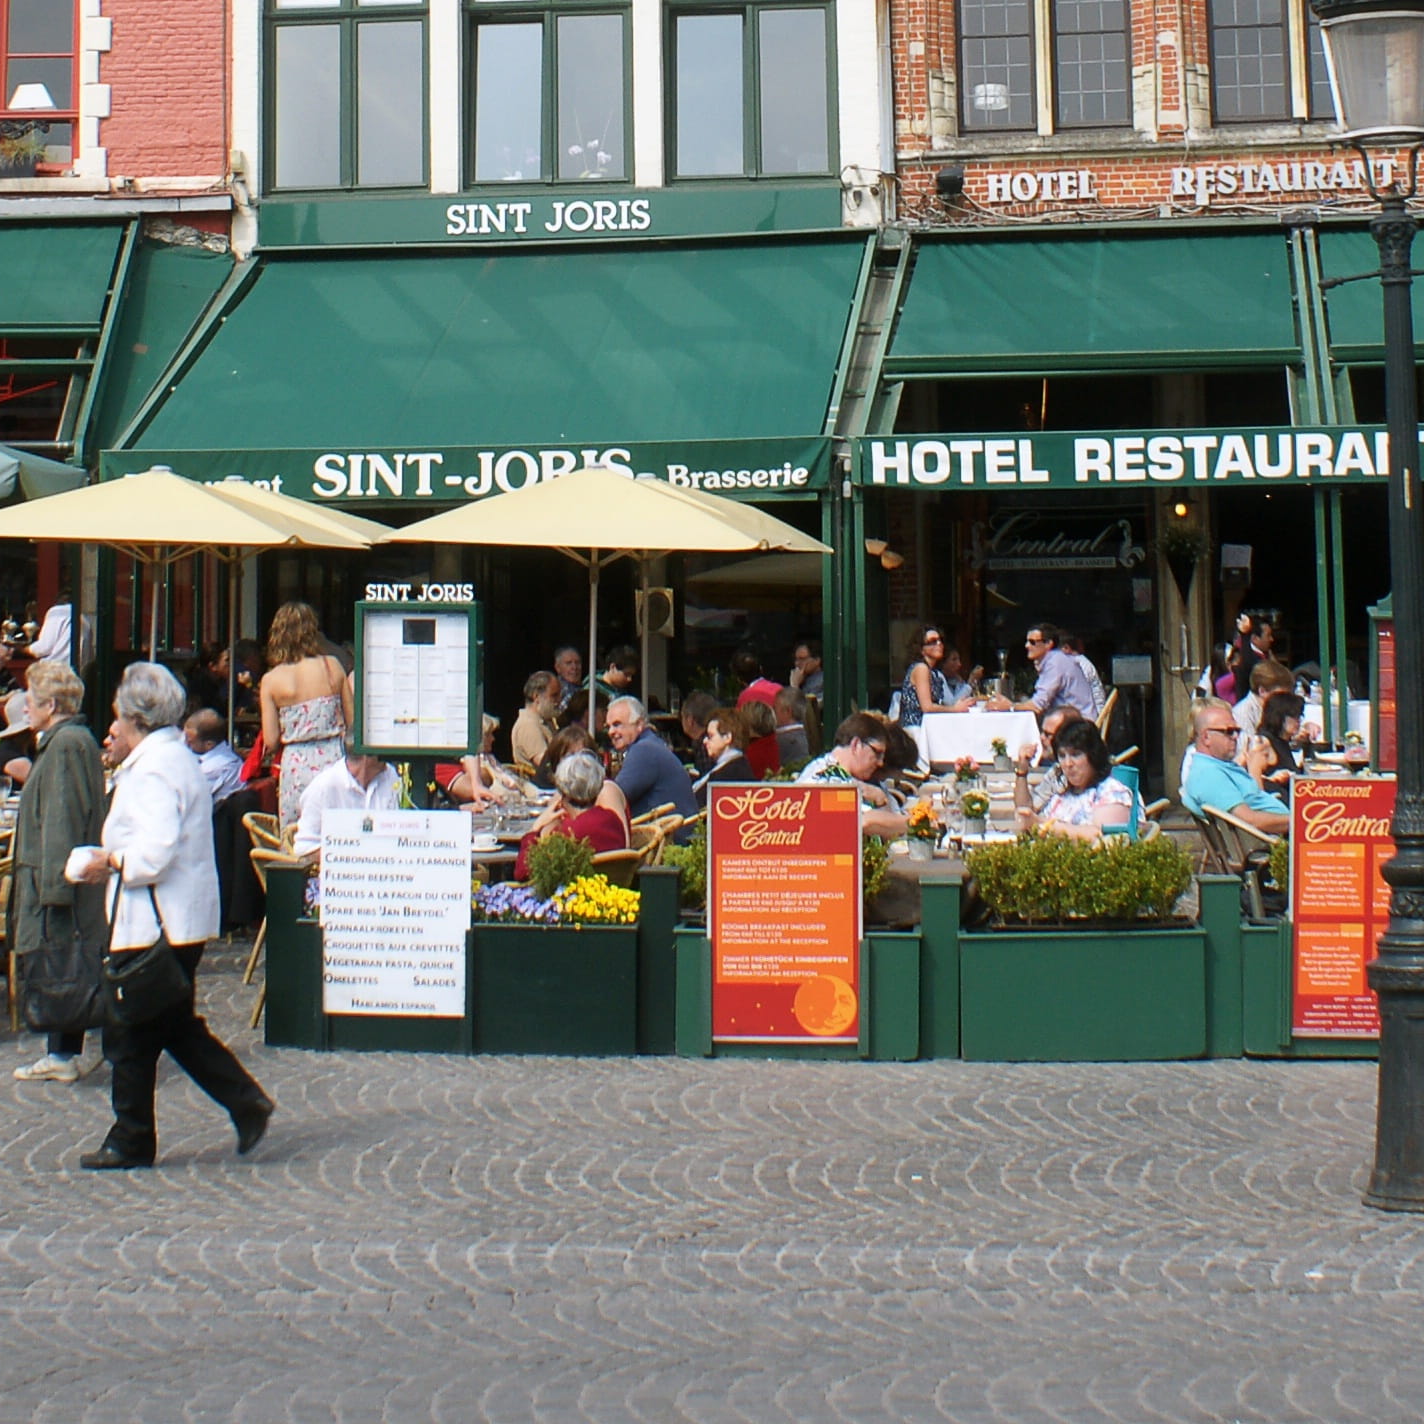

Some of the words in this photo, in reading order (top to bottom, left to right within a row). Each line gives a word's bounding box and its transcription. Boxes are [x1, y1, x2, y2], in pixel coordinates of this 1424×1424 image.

[986, 169, 1097, 203] HOTEL
[1172, 157, 1399, 198] RESTAURANT
[446, 202, 531, 235] SINT
[544, 199, 652, 233] JORIS
[871, 438, 1050, 485] HOTEL
[668, 462, 810, 492] Brasserie
[365, 583, 412, 601] SINT
[417, 583, 475, 601] JORIS
[1294, 780, 1373, 798] Restaurant
[716, 787, 811, 820] Hotel
[1302, 800, 1392, 843] Centra
[325, 835, 361, 846] STEAKS
[397, 836, 430, 848] MIXED
[738, 820, 805, 851] Central
[325, 852, 395, 864] CARBONNADES
[416, 858, 467, 867] FLAMANDE
[325, 870, 366, 881] FLEMISH
[325, 887, 366, 898] MOULES
[377, 891, 389, 899] LA
[425, 892, 438, 901] DU
[441, 892, 464, 901] CHEF
[325, 904, 354, 916] SPARE
[324, 939, 385, 951] CROQUETTES
[388, 943, 407, 951] AUX
[409, 943, 461, 953] CREVETTES
[324, 955, 382, 968] VEGETARIAN
[324, 973, 379, 985] OMELETTES
[413, 975, 457, 987] SALADES
